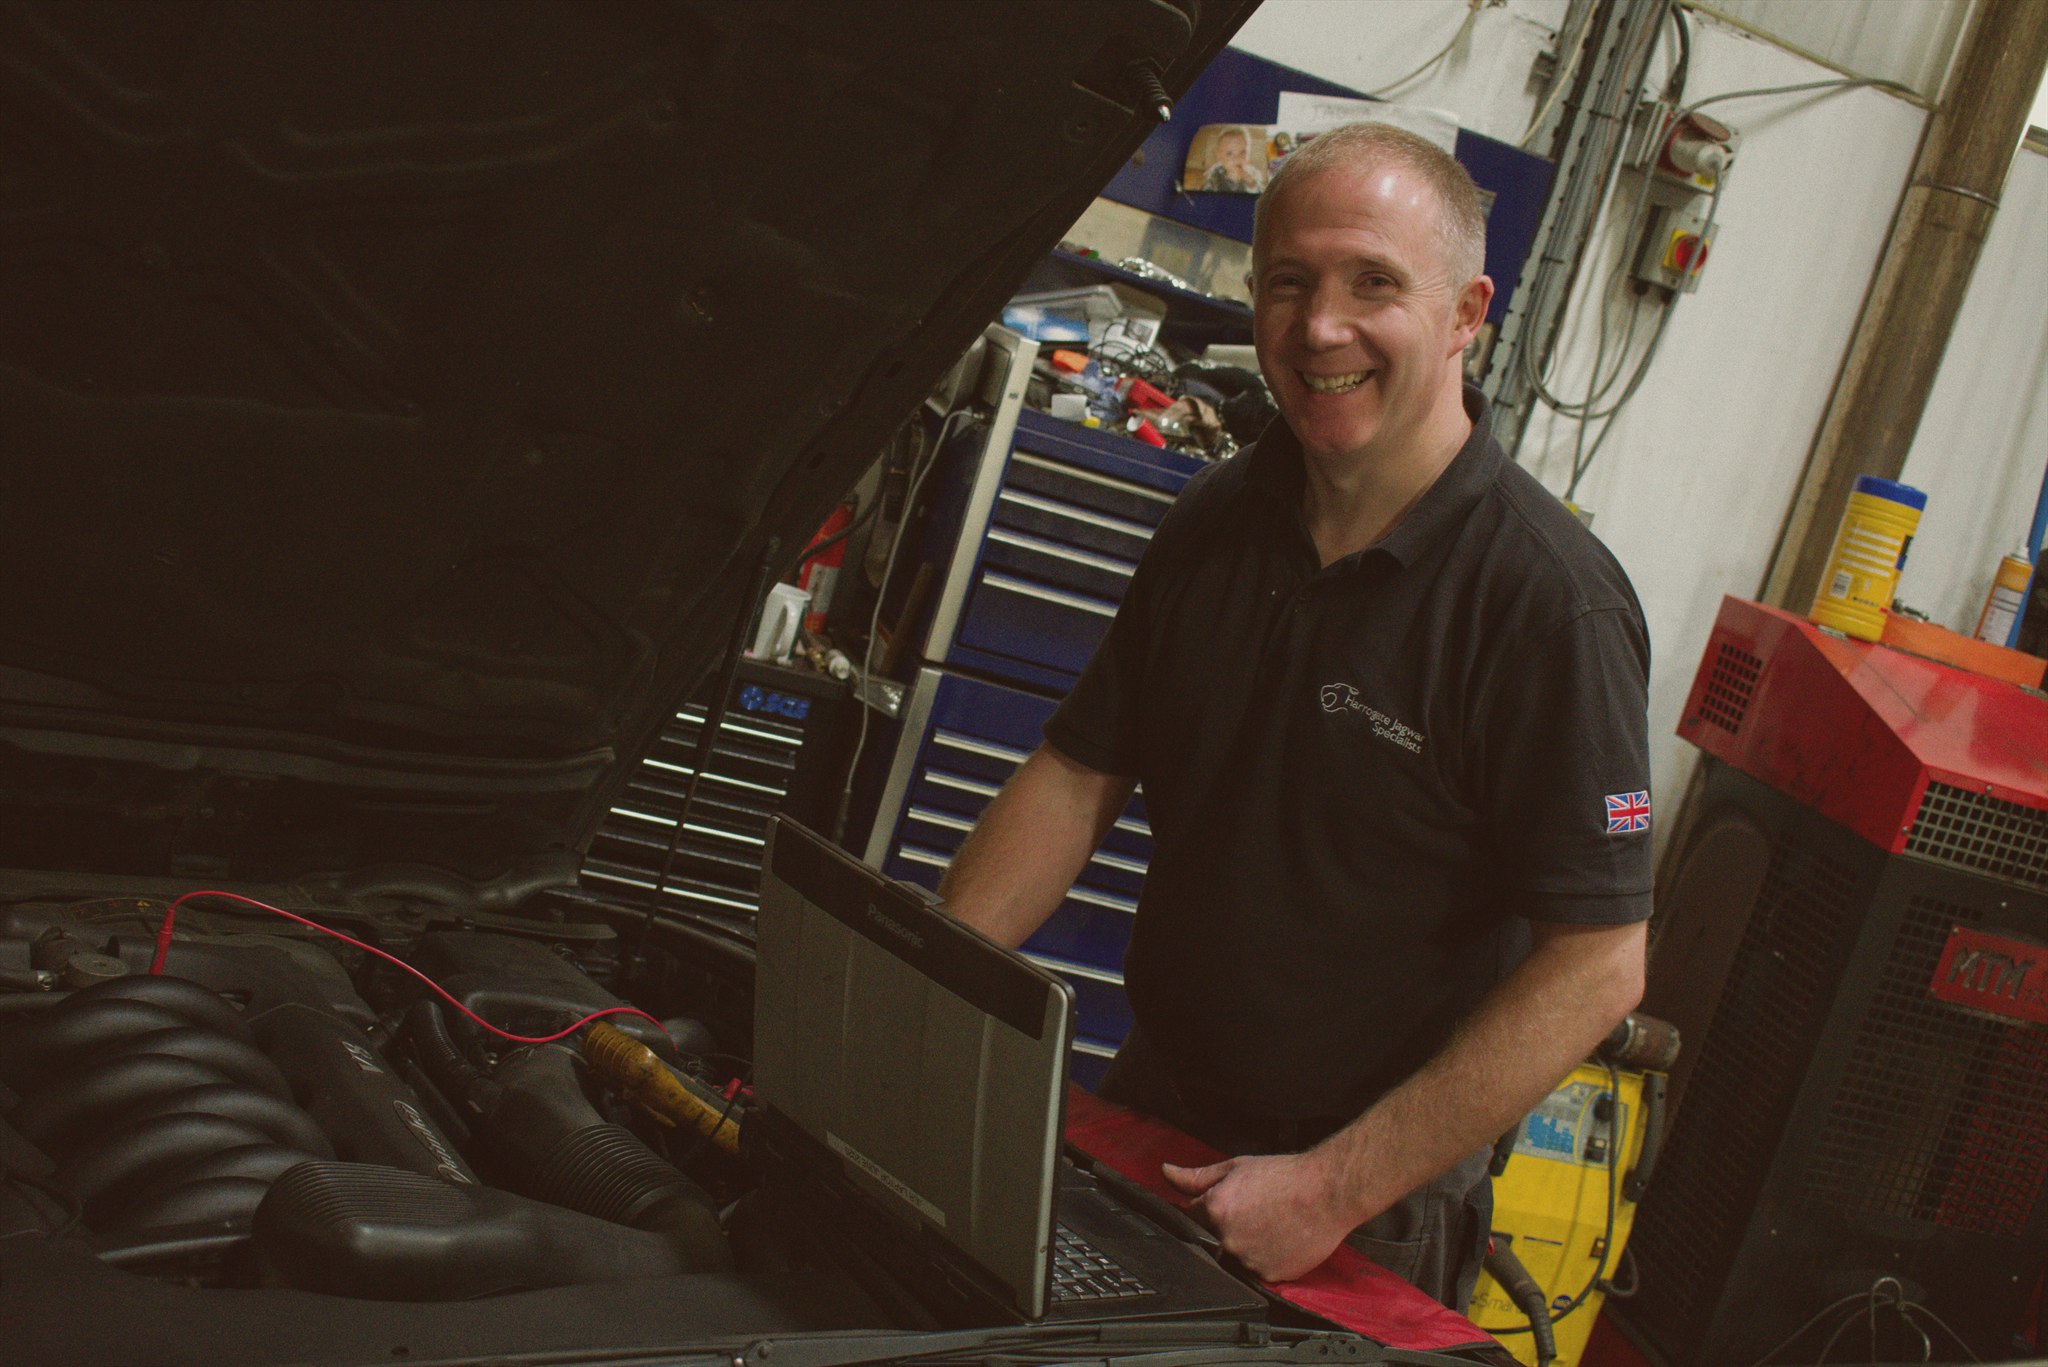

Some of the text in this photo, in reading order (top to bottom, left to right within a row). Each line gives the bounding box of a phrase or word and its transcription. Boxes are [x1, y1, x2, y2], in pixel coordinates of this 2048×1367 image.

[1345, 695, 1426, 743] Harrogate Jagwar
[1372, 722, 1423, 755] Specialists
[867, 903, 926, 949] Panasonic
[1947, 946, 2036, 1000] MTM
